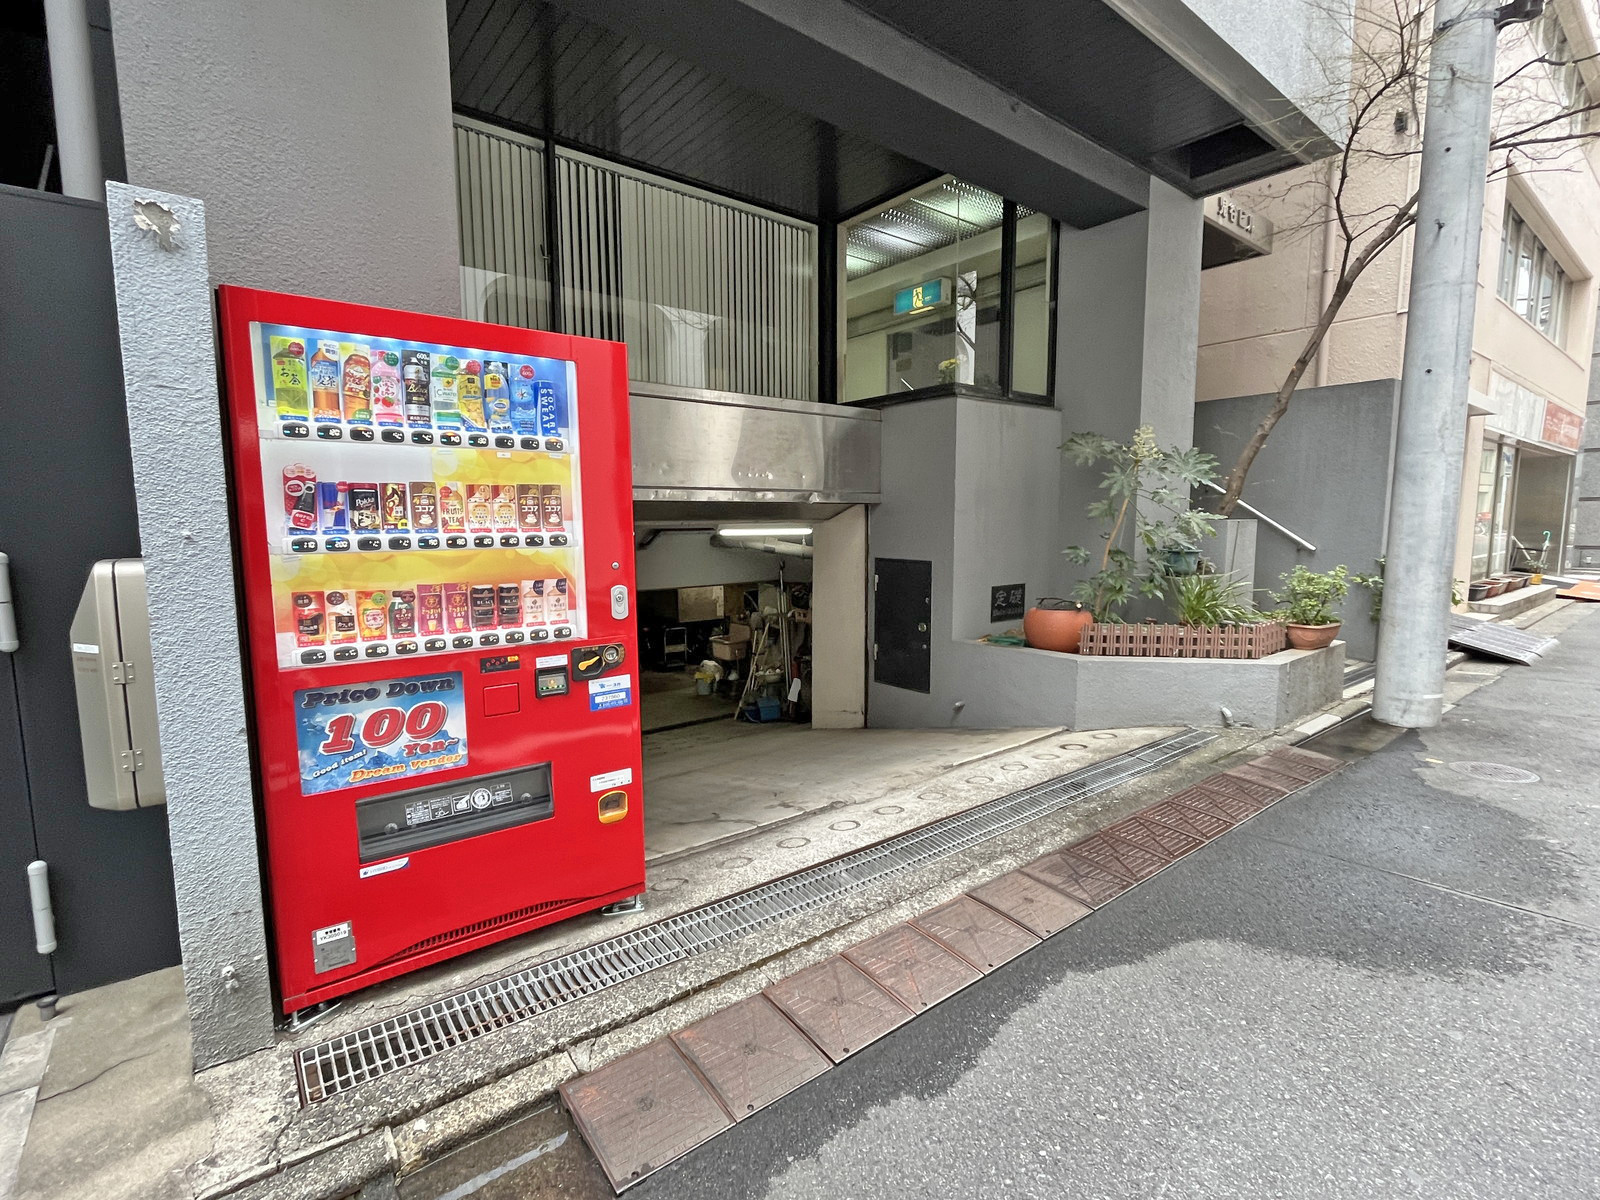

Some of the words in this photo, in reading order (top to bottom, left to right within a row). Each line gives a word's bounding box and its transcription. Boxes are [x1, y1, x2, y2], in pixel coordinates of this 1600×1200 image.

[540, 388, 550, 428] SWEAT
[546, 388, 556, 433] POCARI
[415, 505, 434, 514] ココア
[448, 516, 460, 524] TEA
[521, 505, 538, 513] ココア
[545, 505, 561, 513] ココア
[301, 686, 381, 709] Price
[385, 677, 456, 698] Down
[318, 701, 449, 756] 100
[312, 762, 340, 778] Good
[341, 749, 367, 766] item!
[349, 763, 407, 783] Dream
